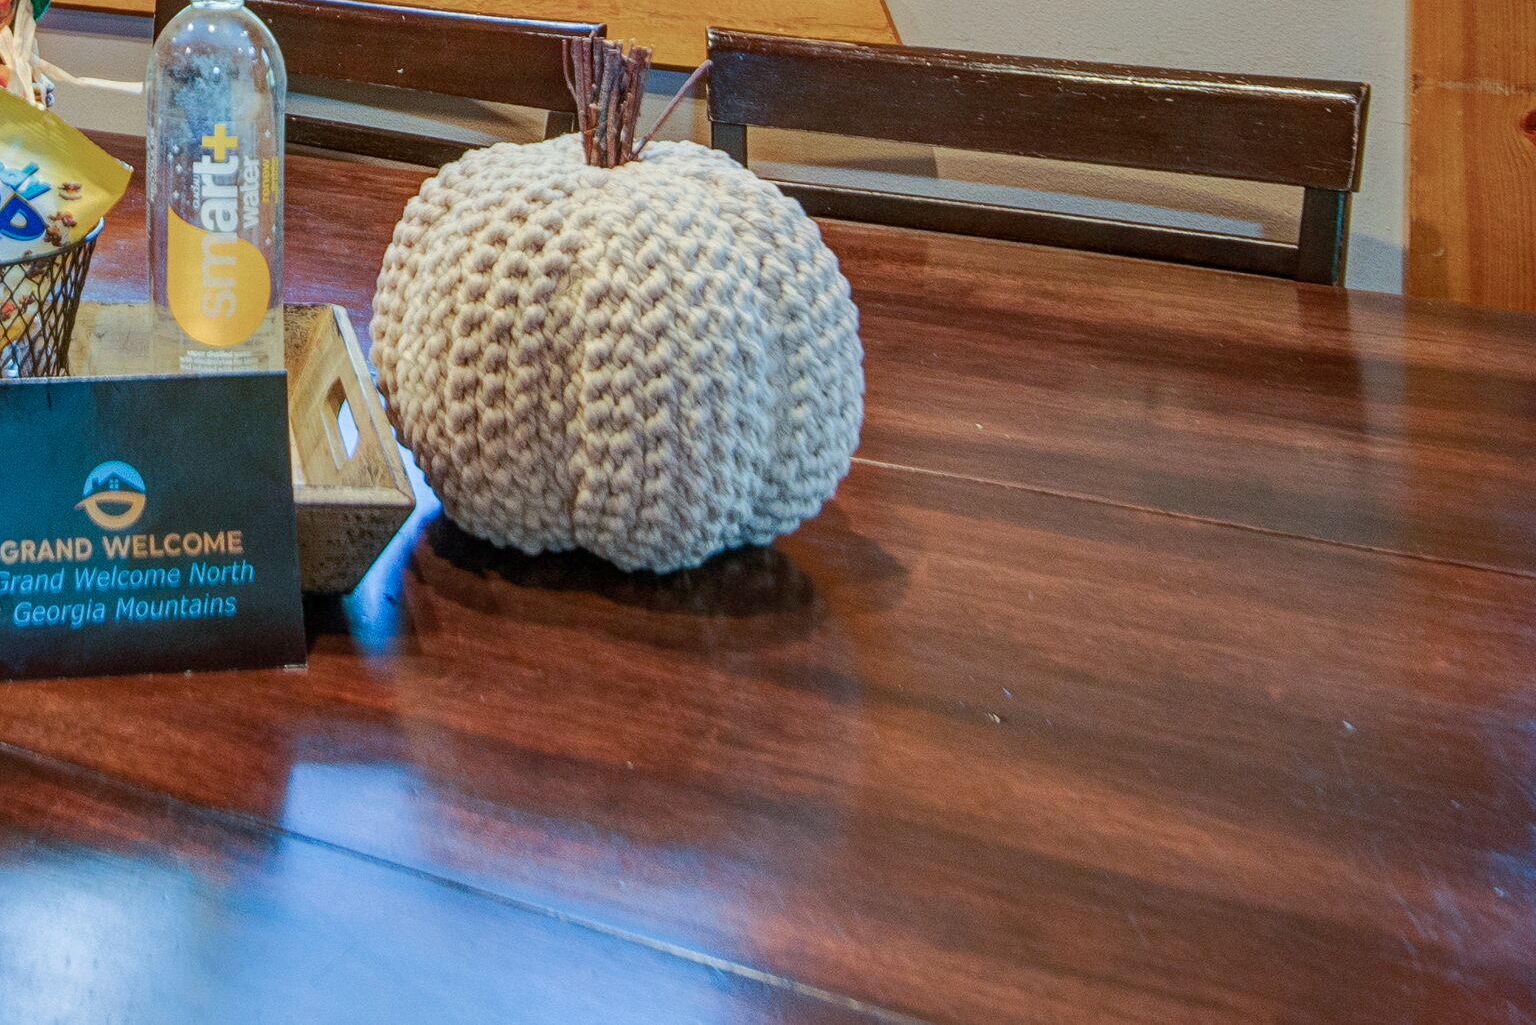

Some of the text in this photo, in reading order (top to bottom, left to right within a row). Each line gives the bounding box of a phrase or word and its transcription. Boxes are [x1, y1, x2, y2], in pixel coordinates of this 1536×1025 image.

[240, 155, 260, 229] water
[0, 530, 244, 564] GRAND WELCOME
[75, 564, 181, 592] Welcome
[188, 560, 255, 587] North
[14, 592, 237, 629] Georgia Mountains
